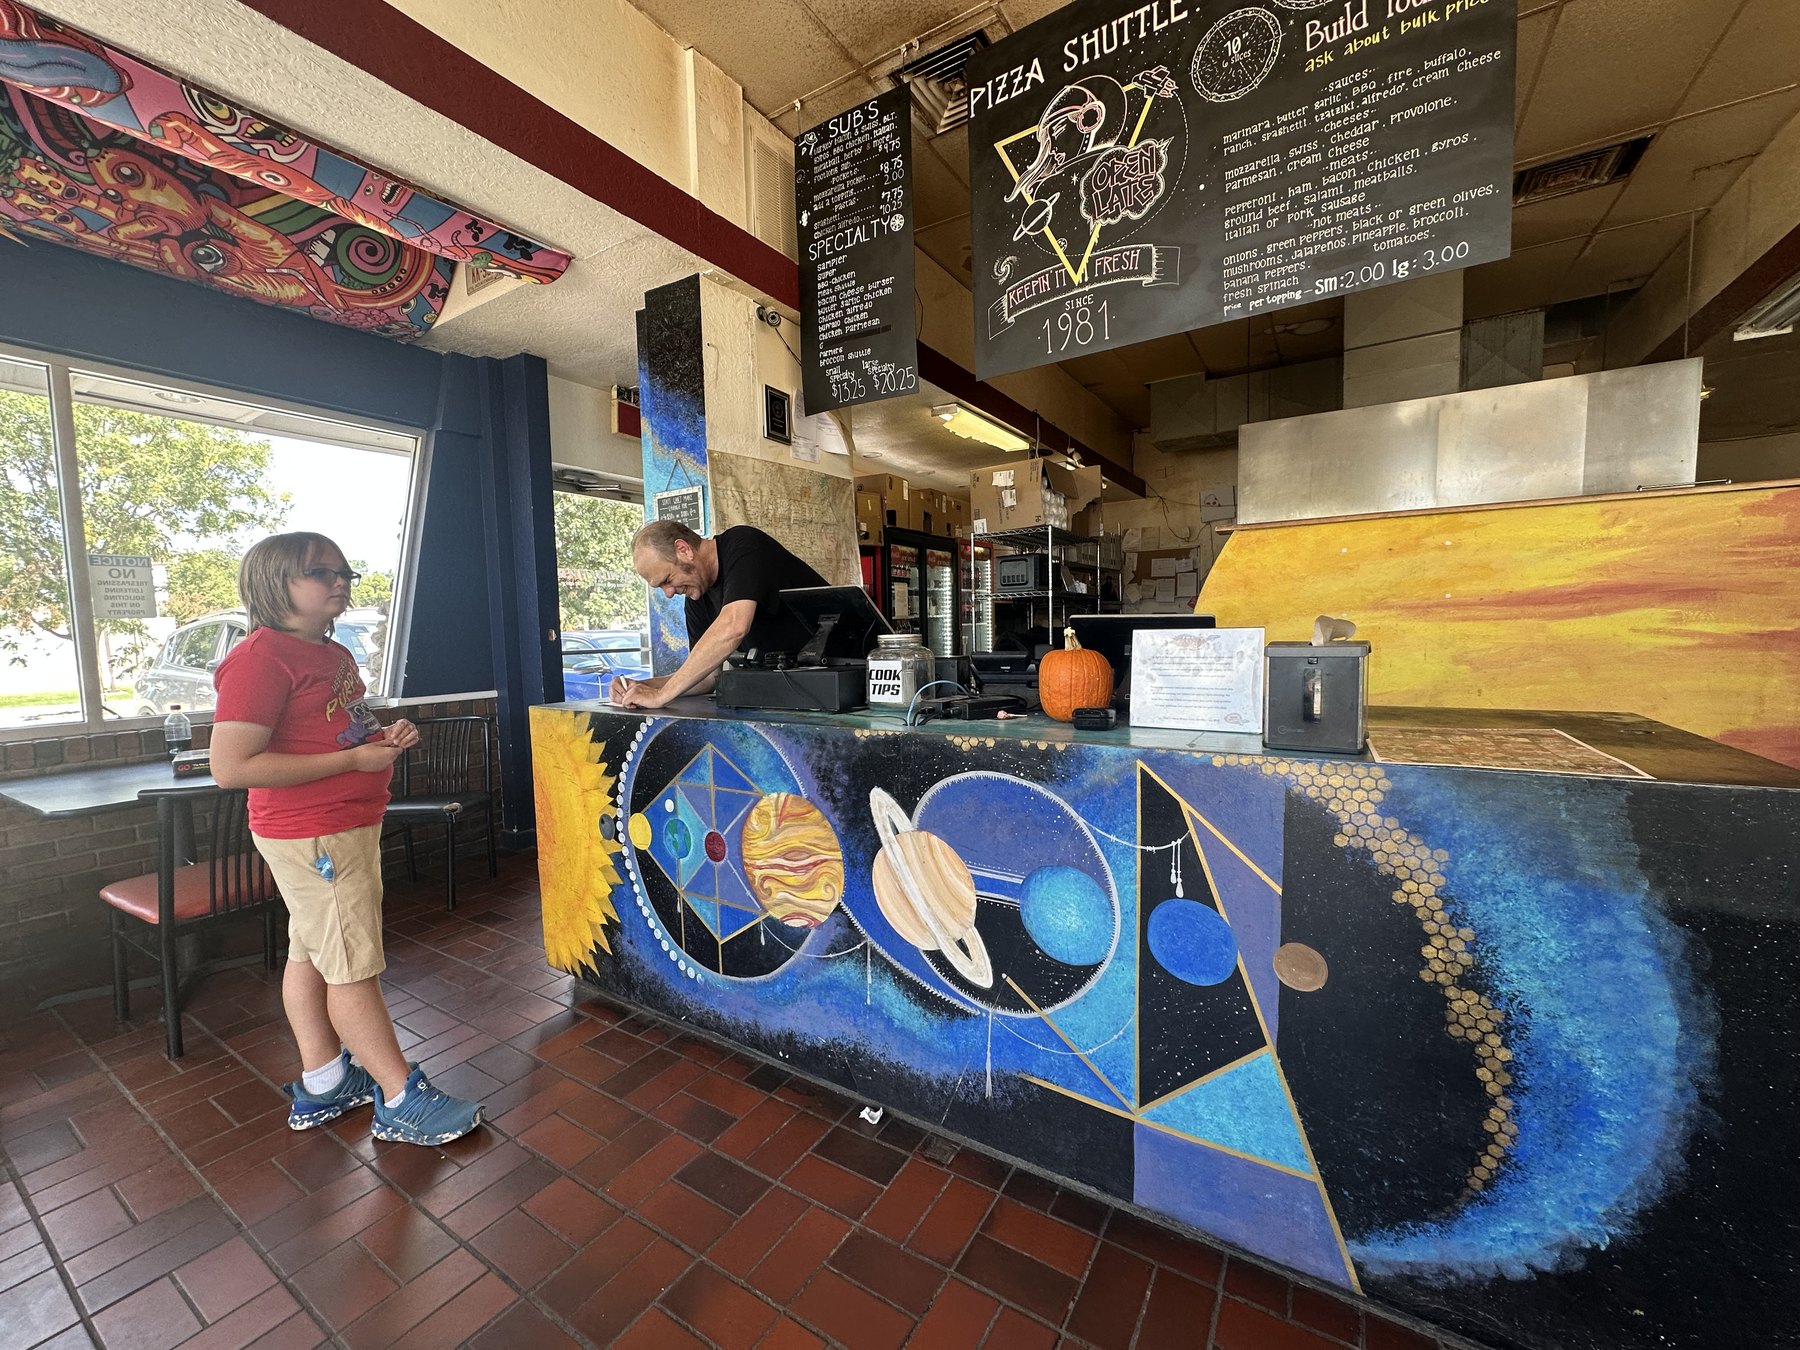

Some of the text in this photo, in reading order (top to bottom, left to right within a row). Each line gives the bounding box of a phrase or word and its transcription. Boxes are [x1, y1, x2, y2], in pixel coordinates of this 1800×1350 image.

[1305, 0, 1369, 52] Build
[1304, 50, 1334, 72] ask
[1343, 25, 1390, 56] about
[1400, 10, 1440, 35] bulk
[1229, 48, 1251, 64] slices
[1412, 67, 1449, 88] cream
[1457, 50, 1501, 72] cheese
[969, 57, 1045, 118] PIZZA
[828, 100, 879, 138] SUB'S
[1276, 105, 1309, 124] butter
[878, 136, 901, 153] $9.75
[1286, 152, 1322, 172] cream
[1327, 137, 1370, 158] cheese
[879, 153, 903, 173] $8.75
[1092, 145, 1156, 192] OPEN
[825, 198, 830, 206] a
[883, 167, 905, 185] 2.00
[881, 184, 903, 202] $7.75
[1091, 173, 1156, 219] LATE
[879, 196, 903, 215] $10.25
[1266, 217, 1279, 229] or
[1287, 206, 1314, 223] pork
[1321, 191, 1365, 213] sausage
[1224, 208, 1263, 229] ground
[1266, 237, 1296, 254] green
[1352, 213, 1383, 231] black
[1388, 209, 1403, 221] or
[1408, 197, 1446, 216] green
[1312, 215, 1332, 229] not
[808, 215, 890, 261] SPECIALTY
[817, 254, 848, 272] sampler
[817, 268, 837, 281] super
[1055, 268, 1067, 289] IT
[1094, 249, 1141, 278] FRESH
[817, 279, 856, 298] meat shuttle
[817, 276, 895, 307] bacon cheese burger
[1223, 302, 1242, 317] price
[1249, 298, 1264, 311] per
[1422, 241, 1469, 270] 3.00
[1223, 273, 1259, 290] banana
[1223, 275, 1299, 303] fresh spinach
[817, 286, 892, 316] butter garlic chicken
[818, 300, 873, 324] chicken alfredo
[1065, 294, 1094, 311] SINCE
[818, 317, 880, 341] chicken parmesan
[843, 311, 869, 324] chicken
[1042, 299, 1110, 355] 1981
[819, 347, 871, 367] broccoli shuttle
[825, 365, 841, 377] small
[872, 366, 916, 394] $20.25
[831, 377, 866, 403] $13.25
[869, 668, 901, 681] COOK
[871, 683, 900, 696] TIPS
